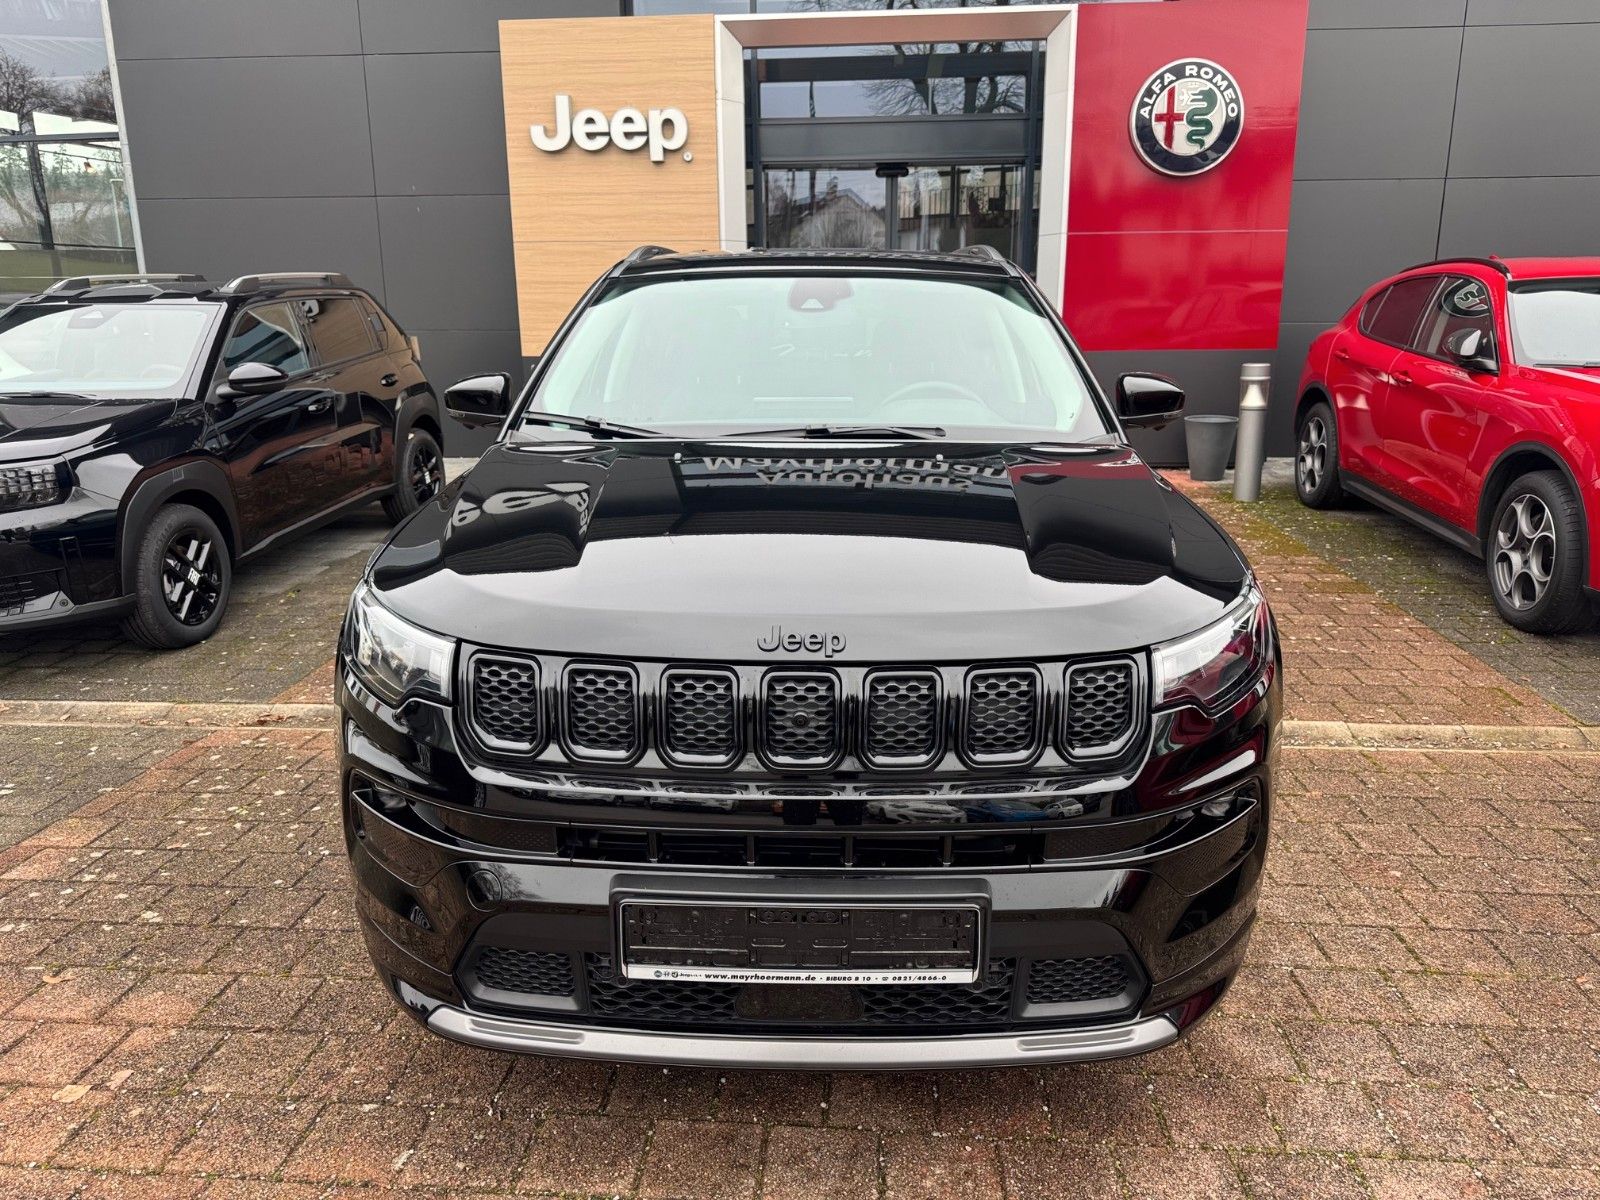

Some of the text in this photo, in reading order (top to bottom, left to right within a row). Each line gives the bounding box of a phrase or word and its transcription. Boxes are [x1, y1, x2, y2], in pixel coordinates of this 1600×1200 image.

[1140, 64, 1238, 119] ALFA ROMEO
[529, 94, 689, 163] Jeep
[756, 624, 847, 658] Jeep
[704, 972, 816, 982] www.mayrhoermann.de
